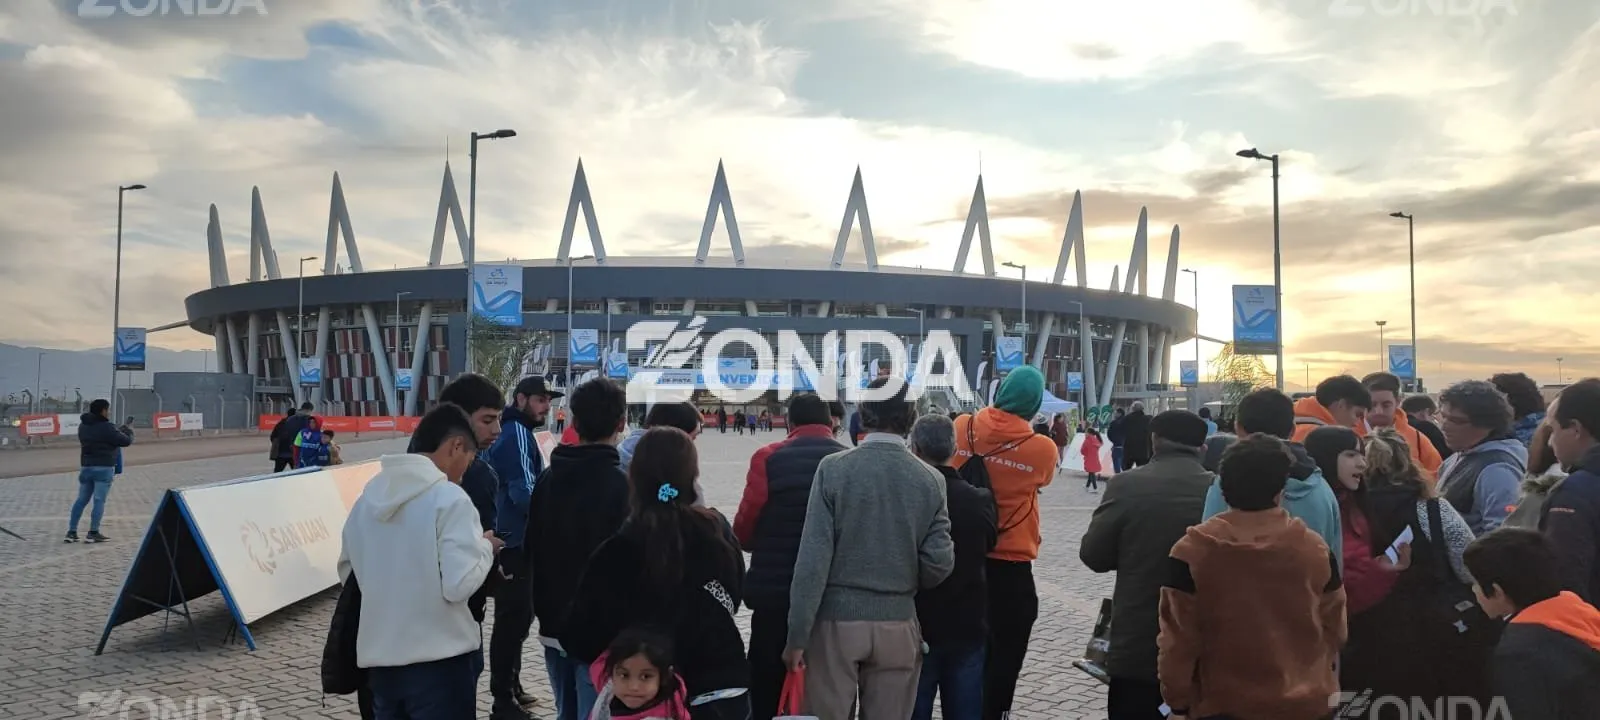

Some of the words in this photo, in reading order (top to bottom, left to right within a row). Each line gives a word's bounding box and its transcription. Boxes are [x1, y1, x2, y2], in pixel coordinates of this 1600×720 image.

[954, 450, 1034, 473] VOLTARIOS
[270, 522, 302, 554] SAN
[296, 516, 330, 544] JUAN
